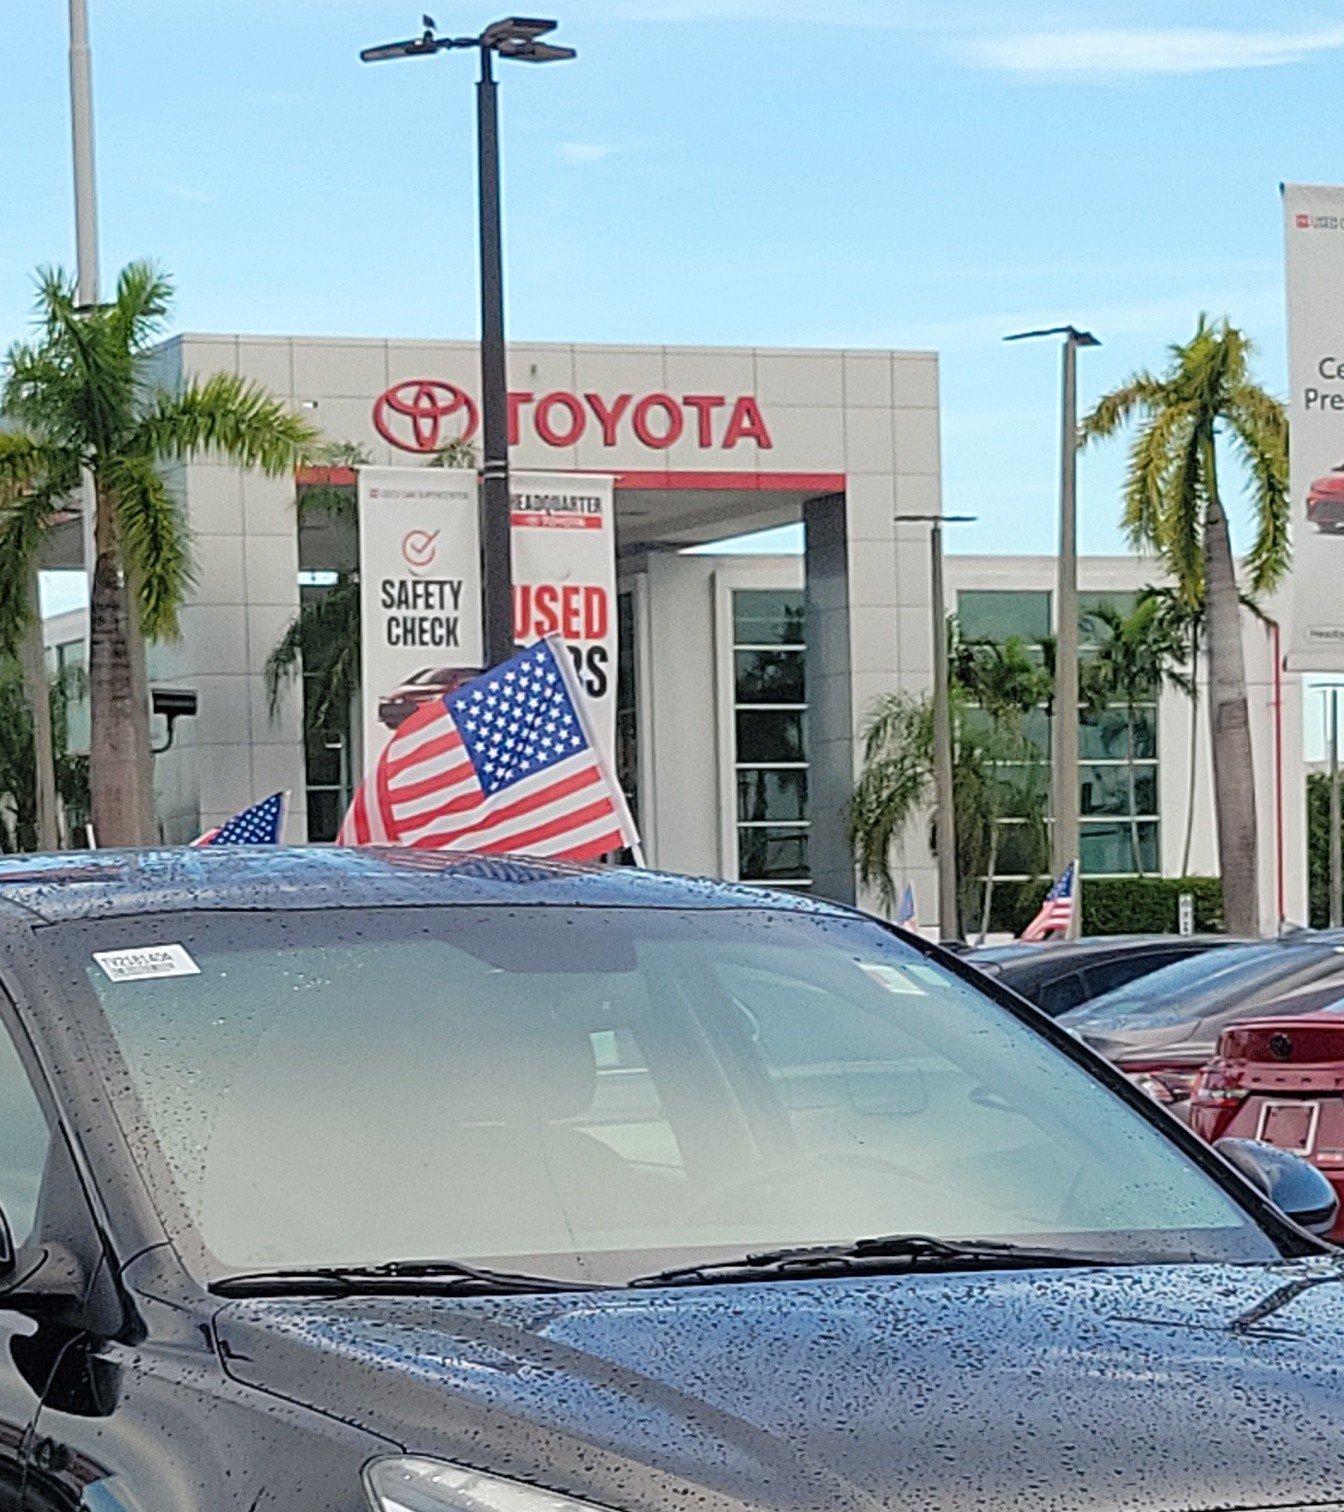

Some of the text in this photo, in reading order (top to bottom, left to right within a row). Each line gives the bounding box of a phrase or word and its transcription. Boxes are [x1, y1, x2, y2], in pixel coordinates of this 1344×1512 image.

[508, 391, 774, 450] TOYOTA
[381, 579, 464, 612] SAFETY
[513, 584, 609, 640] USED
[386, 616, 460, 648] CHECK
